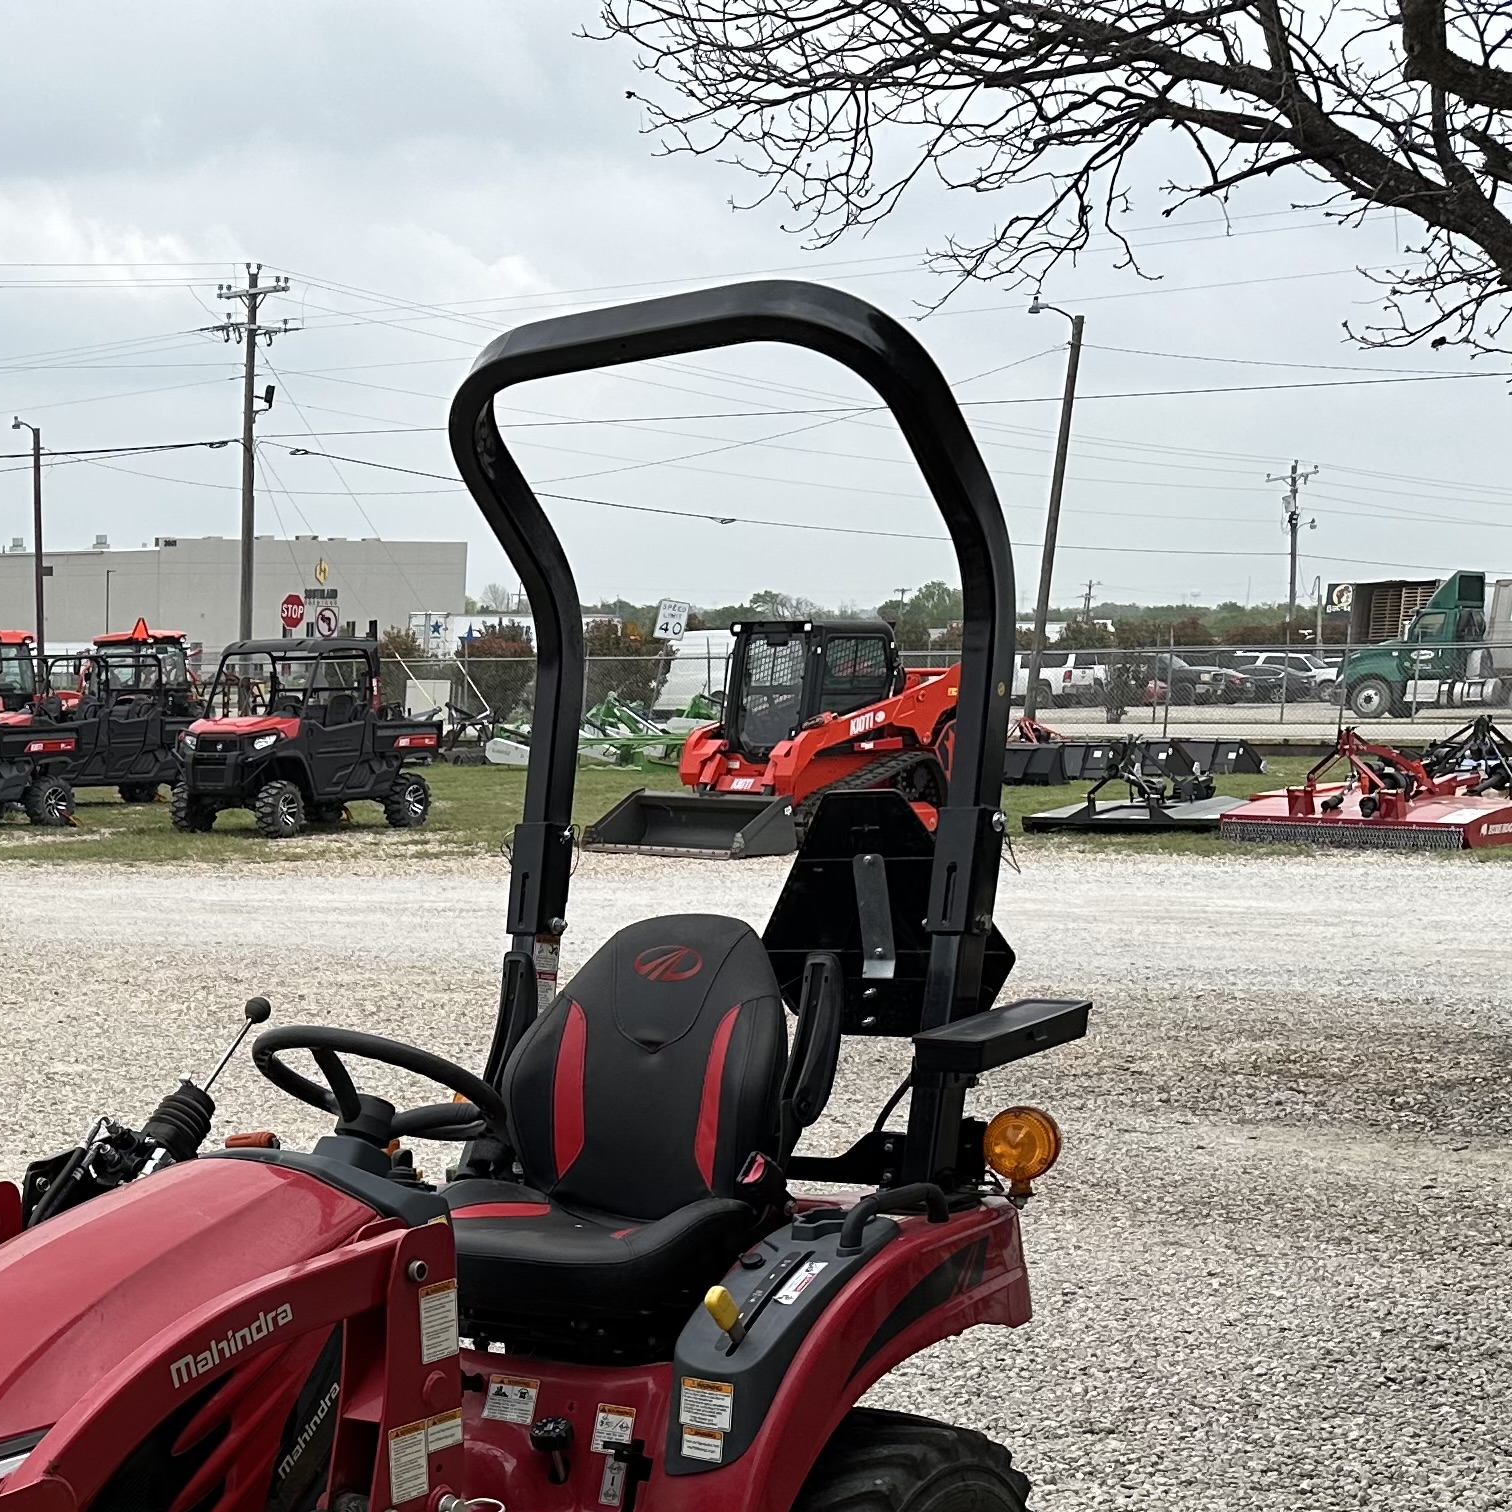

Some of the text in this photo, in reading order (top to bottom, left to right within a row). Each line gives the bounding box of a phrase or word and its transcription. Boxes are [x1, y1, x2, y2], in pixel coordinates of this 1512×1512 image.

[281, 604, 304, 619] STOP
[658, 621, 683, 635] 40
[849, 711, 875, 736] KIOTI
[169, 1302, 294, 1390] Mahindra
[277, 1382, 340, 1480] Mahindra
